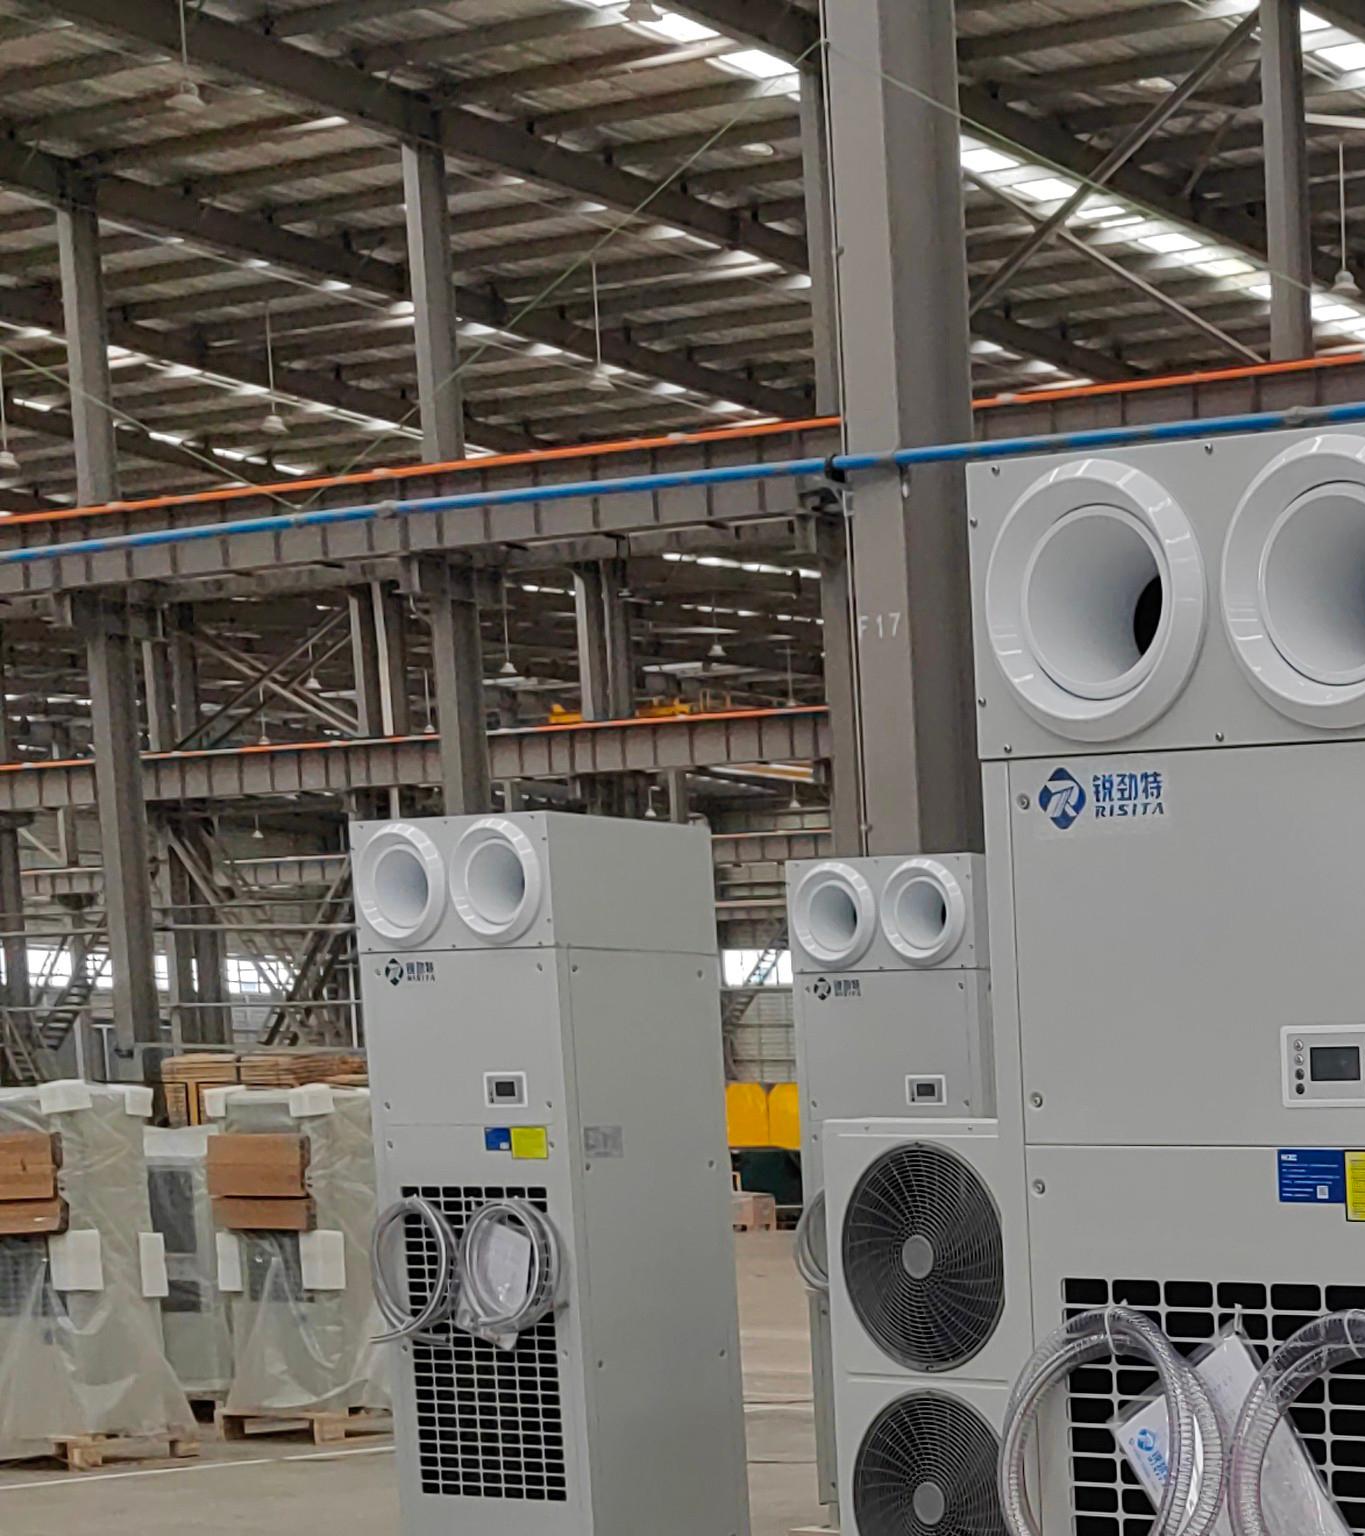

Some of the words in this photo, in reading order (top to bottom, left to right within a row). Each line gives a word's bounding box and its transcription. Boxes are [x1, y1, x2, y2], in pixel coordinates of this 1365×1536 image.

[858, 611, 901, 640] F17
[1092, 771, 1163, 802] 锐劲特
[1095, 802, 1164, 818] RISITA
